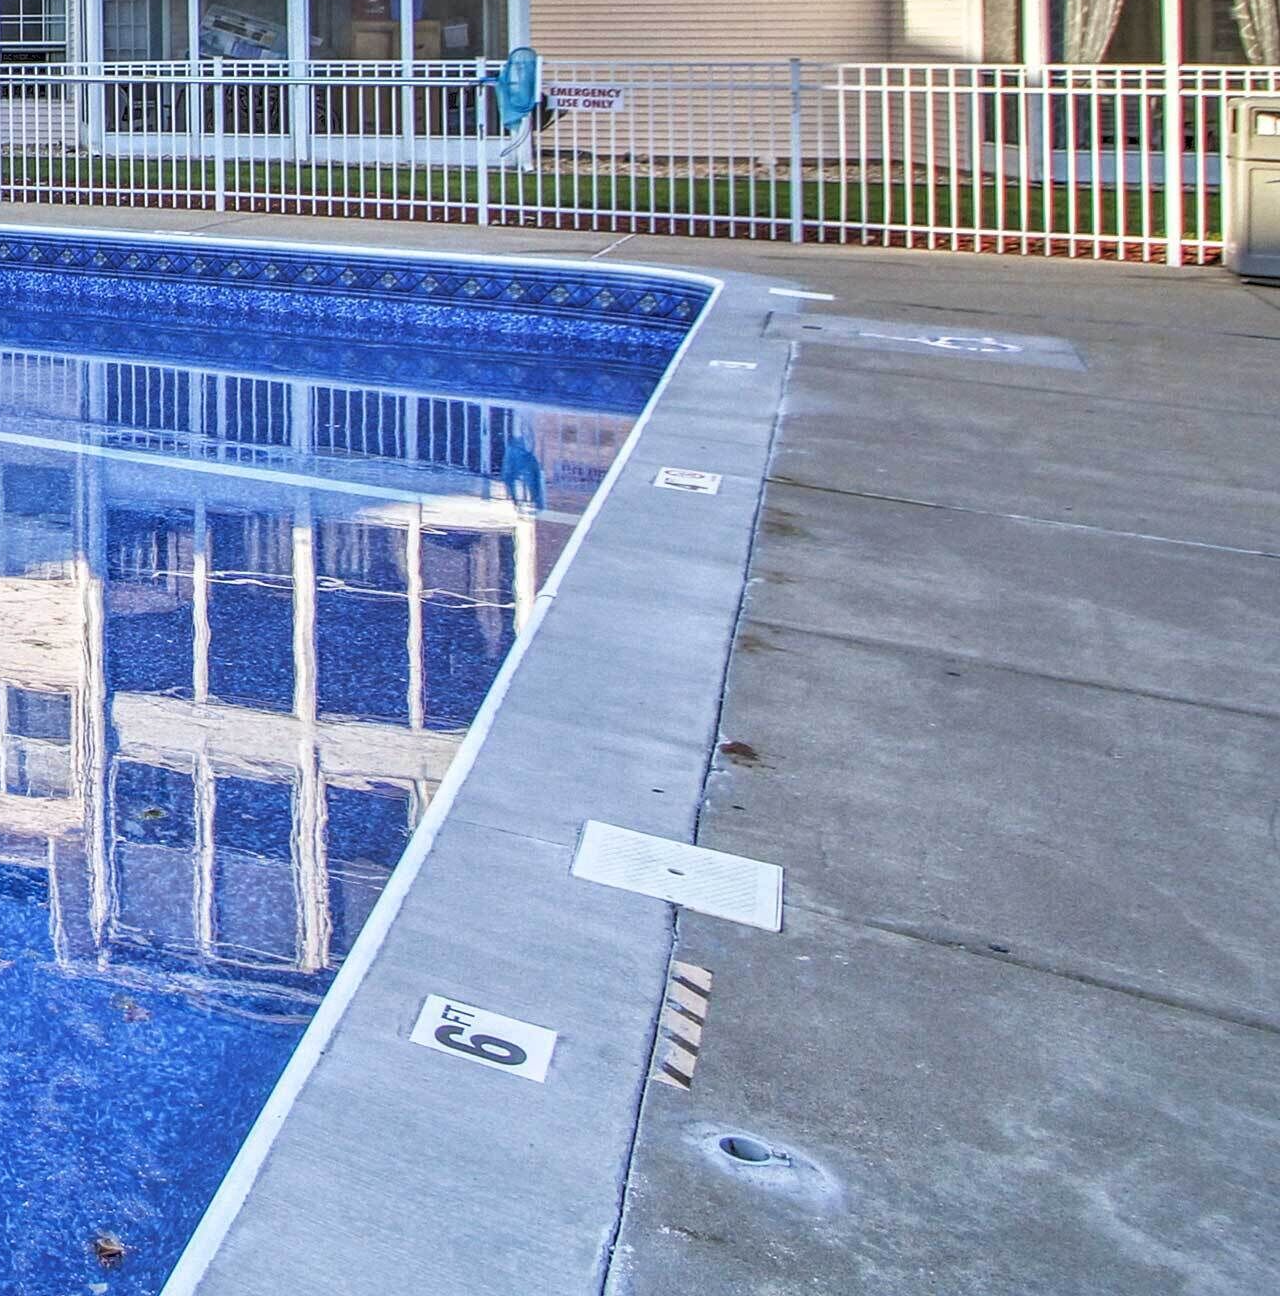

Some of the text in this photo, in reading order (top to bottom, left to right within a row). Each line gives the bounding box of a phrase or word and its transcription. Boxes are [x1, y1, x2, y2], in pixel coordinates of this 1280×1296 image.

[549, 87, 622, 98] EMERGENCY
[557, 98, 614, 109] USE ONLY
[434, 1004, 527, 1066] 6 FT
